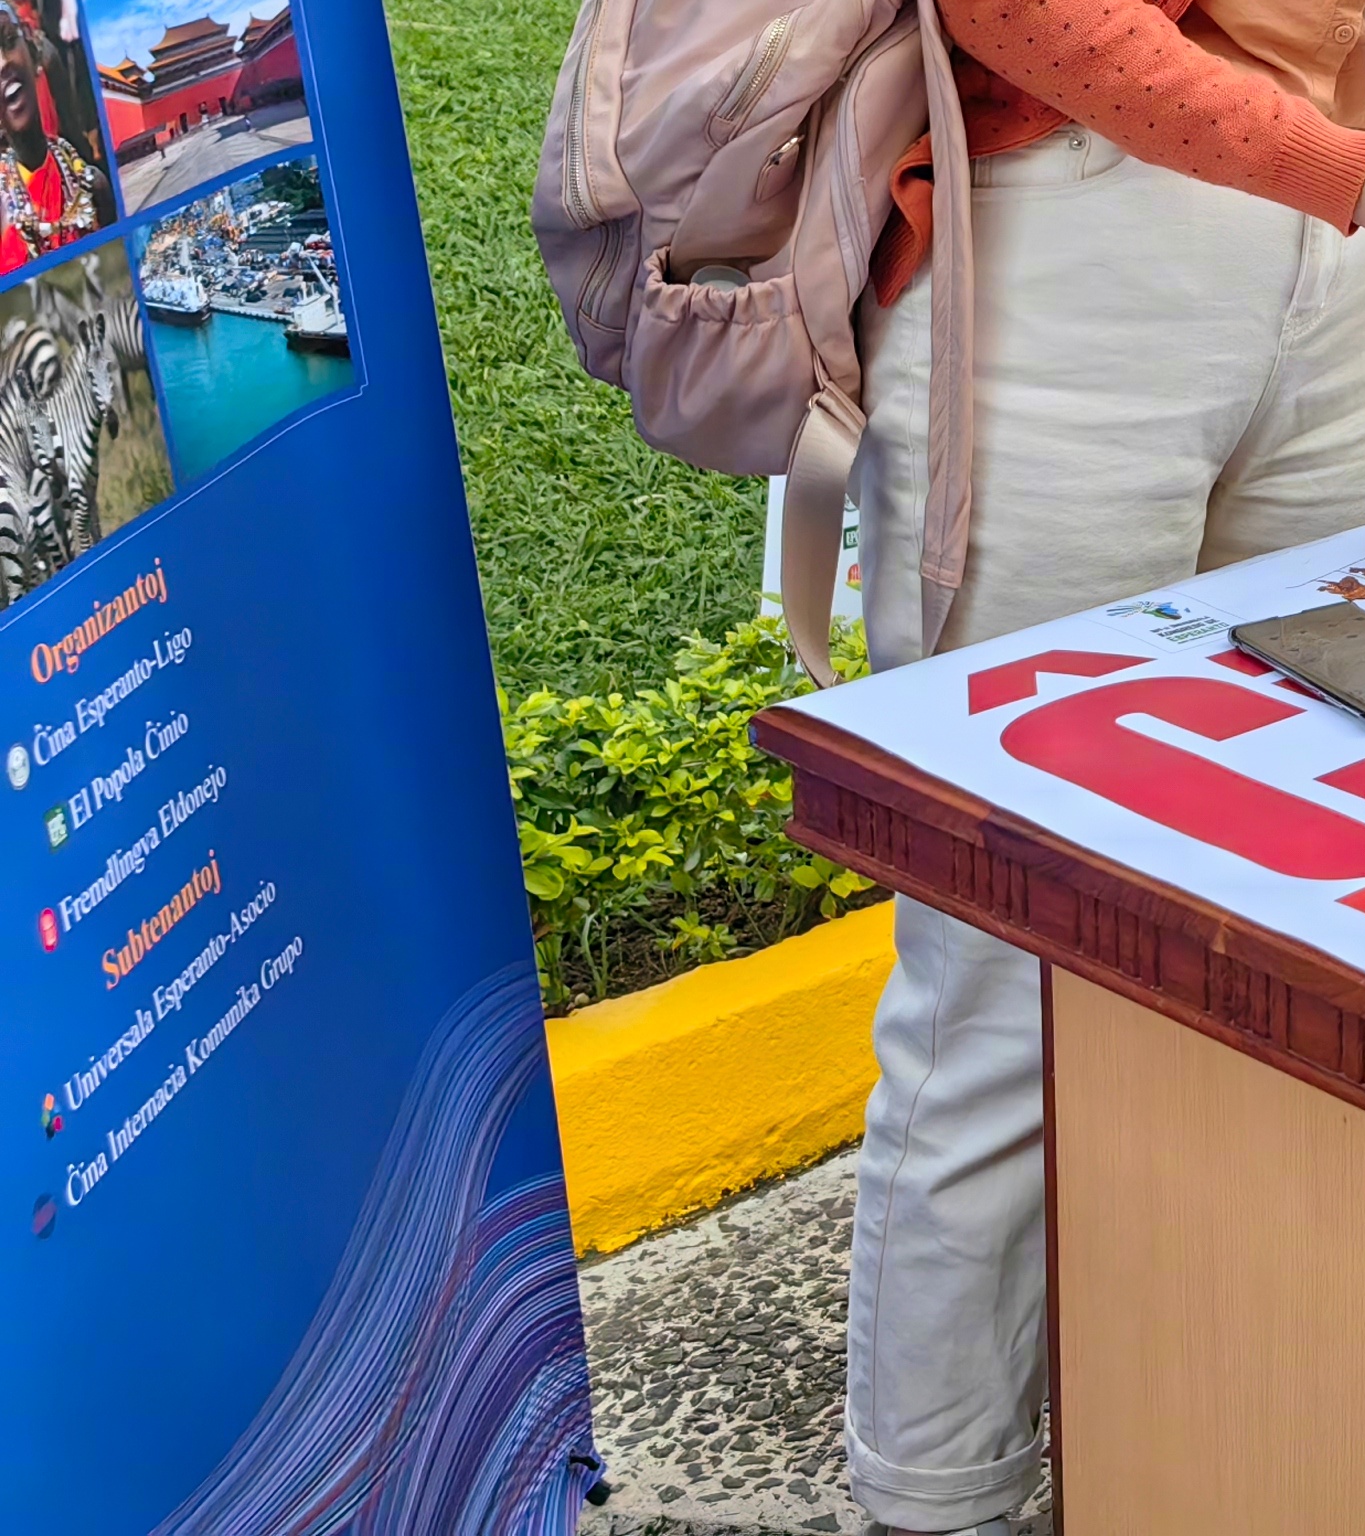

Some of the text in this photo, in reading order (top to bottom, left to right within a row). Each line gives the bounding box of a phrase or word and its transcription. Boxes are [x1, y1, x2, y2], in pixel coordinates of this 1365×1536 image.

[31, 558, 168, 683] Organizantoj
[76, 627, 192, 734] Esperanto-Ligo
[58, 763, 227, 933] Fremdlingva Eldonejo
[69, 793, 93, 830] El
[91, 747, 147, 810] Popola
[102, 849, 222, 990] Subtenantoj
[64, 879, 276, 1112] Universala Esperanto-Asocio
[107, 1062, 189, 1163] Internacia
[185, 986, 262, 1075] Komunika
[260, 936, 304, 992] Grupo
